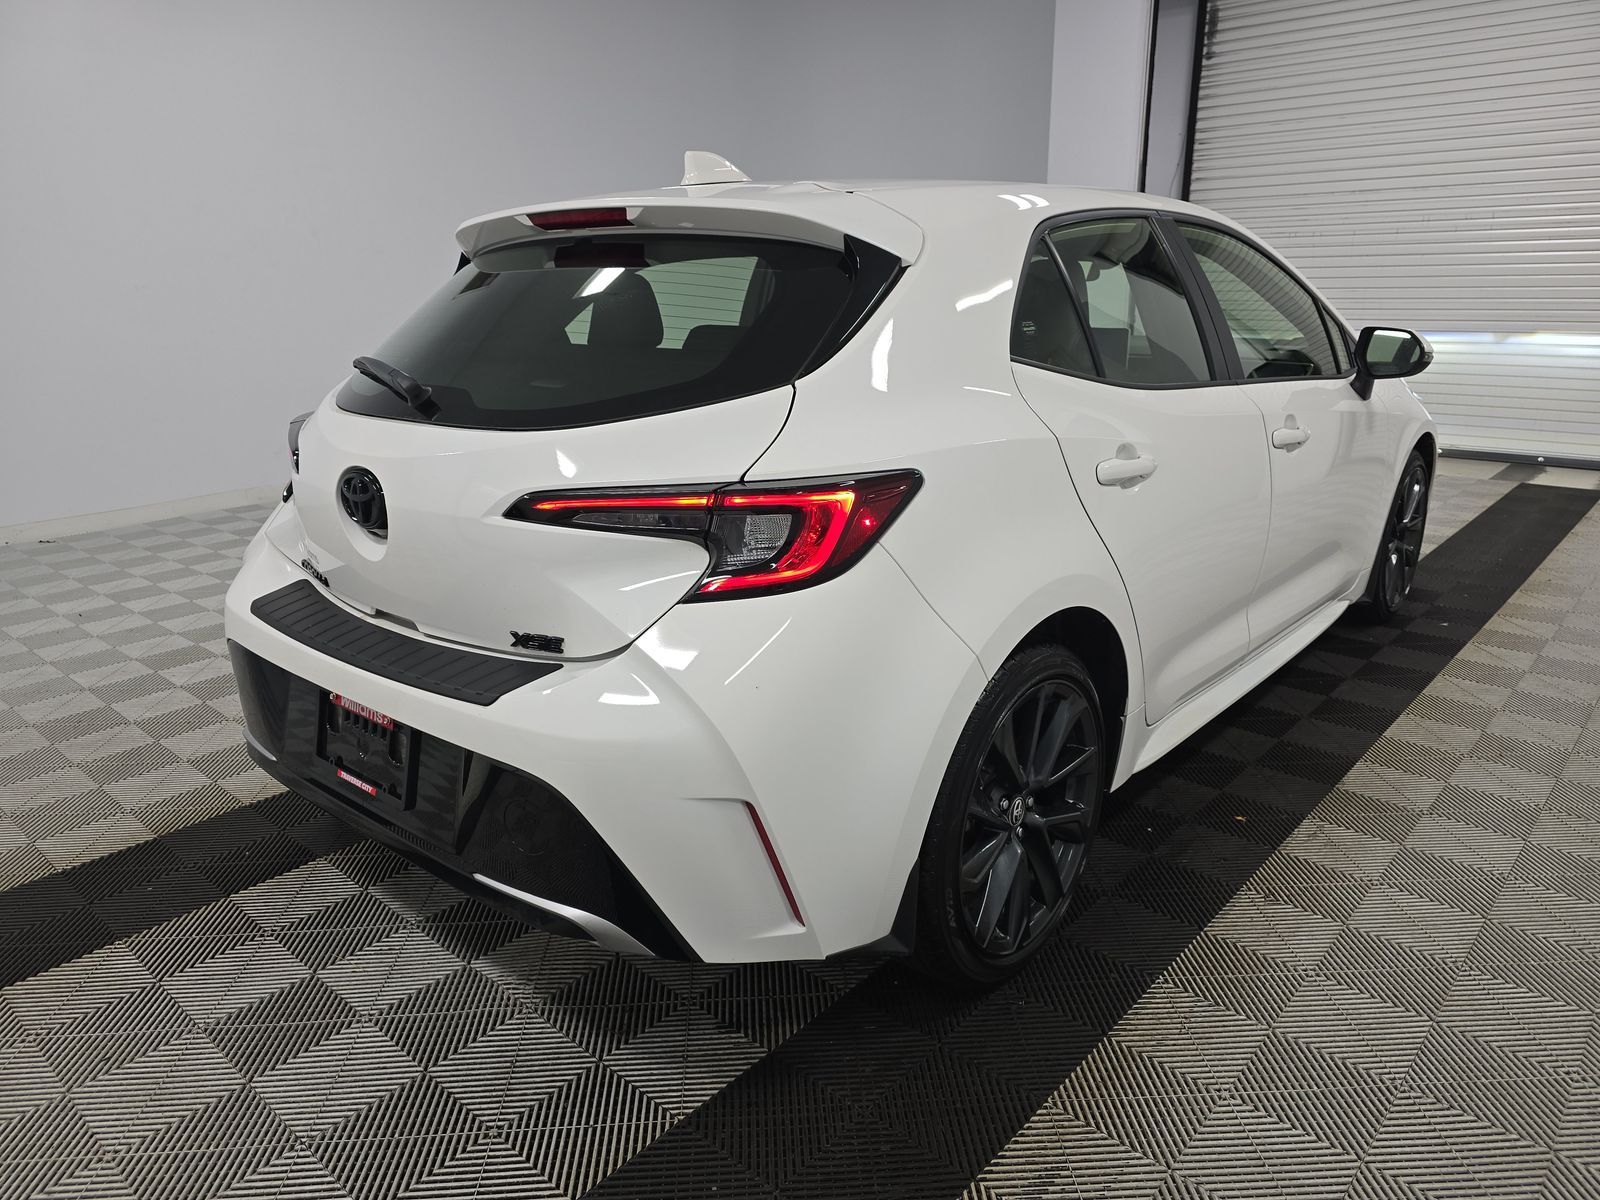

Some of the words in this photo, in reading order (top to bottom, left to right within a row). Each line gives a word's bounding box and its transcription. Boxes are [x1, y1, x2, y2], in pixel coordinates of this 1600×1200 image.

[509, 630, 564, 654] XSE
[341, 695, 383, 723] Williams
[361, 782, 373, 793] CITY
